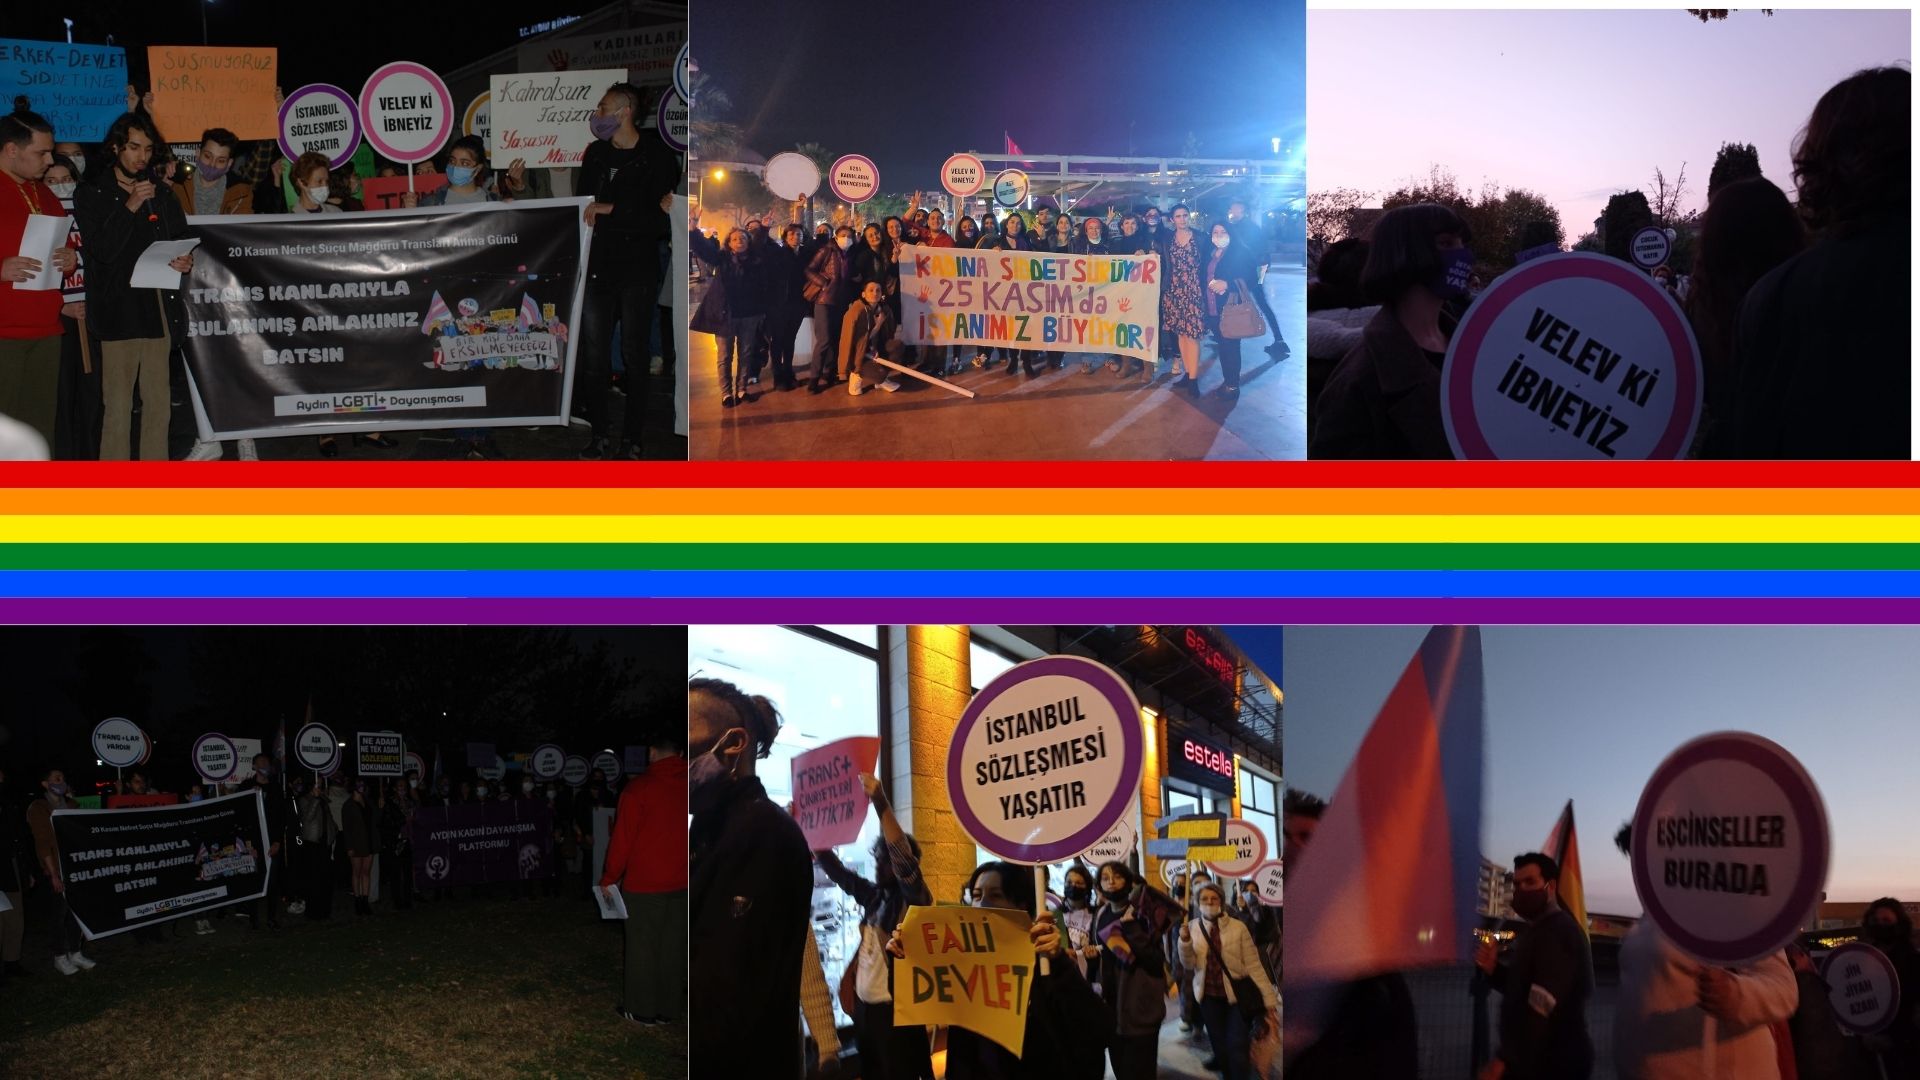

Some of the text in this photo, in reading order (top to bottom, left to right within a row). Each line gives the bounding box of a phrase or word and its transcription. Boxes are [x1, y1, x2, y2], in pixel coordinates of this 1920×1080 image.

[162, 51, 272, 70] SUSMUYORUZ
[379, 92, 433, 111] VELEV Kİ
[500, 76, 592, 103] Kahrolsun
[295, 103, 340, 119] İSTANBUL
[291, 119, 348, 137] SÖZLEŞMESİ
[383, 116, 433, 132] İBNEYİZ
[499, 129, 558, 150] Yaşasın
[228, 246, 243, 257] 20
[244, 245, 279, 257] Kasım
[281, 244, 316, 255] Nefret
[318, 243, 347, 256] Suçu
[348, 239, 400, 254] Mağduru
[487, 233, 518, 245] Günü
[915, 253, 988, 279] KADINA
[190, 280, 410, 304] TRANS KANLARIYLA
[937, 278, 973, 308] 25
[187, 312, 419, 337] SULANMIŞ AHLAKINIZ
[919, 311, 1031, 343] İSYANIMIZ
[263, 347, 344, 365] BATSIN
[1525, 307, 1661, 408] VELEV Kİ
[297, 393, 464, 412] Aydın LGBTİ+ Dayanışması
[1497, 353, 1629, 458] İBNEYİZ
[986, 696, 1085, 745] İSTANBUL
[362, 737, 397, 746] NE ADAM
[975, 726, 1107, 786] SÖZLEŞMESİ
[1184, 740, 1232, 778] estella
[797, 755, 851, 790] TRANS+
[1000, 780, 1086, 821] YAŞATIR
[430, 830, 456, 841] AYDIN
[458, 827, 485, 838] KADIN
[1242, 834, 1252, 846] Kİ
[1656, 810, 1786, 850] EŞCİNSELLER
[70, 839, 191, 863] TRANS KANLARIYLA
[458, 840, 510, 852] PLATFORMU
[69, 863, 132, 883] SULANMIŞ
[134, 854, 195, 871] AHLAKINIZ
[1664, 858, 1771, 897] BURADA
[114, 877, 157, 893] BATSIN
[1265, 887, 1277, 897] YİZ
[921, 916, 995, 954] FAİLİ
[912, 964, 1028, 1016] DEVLET
